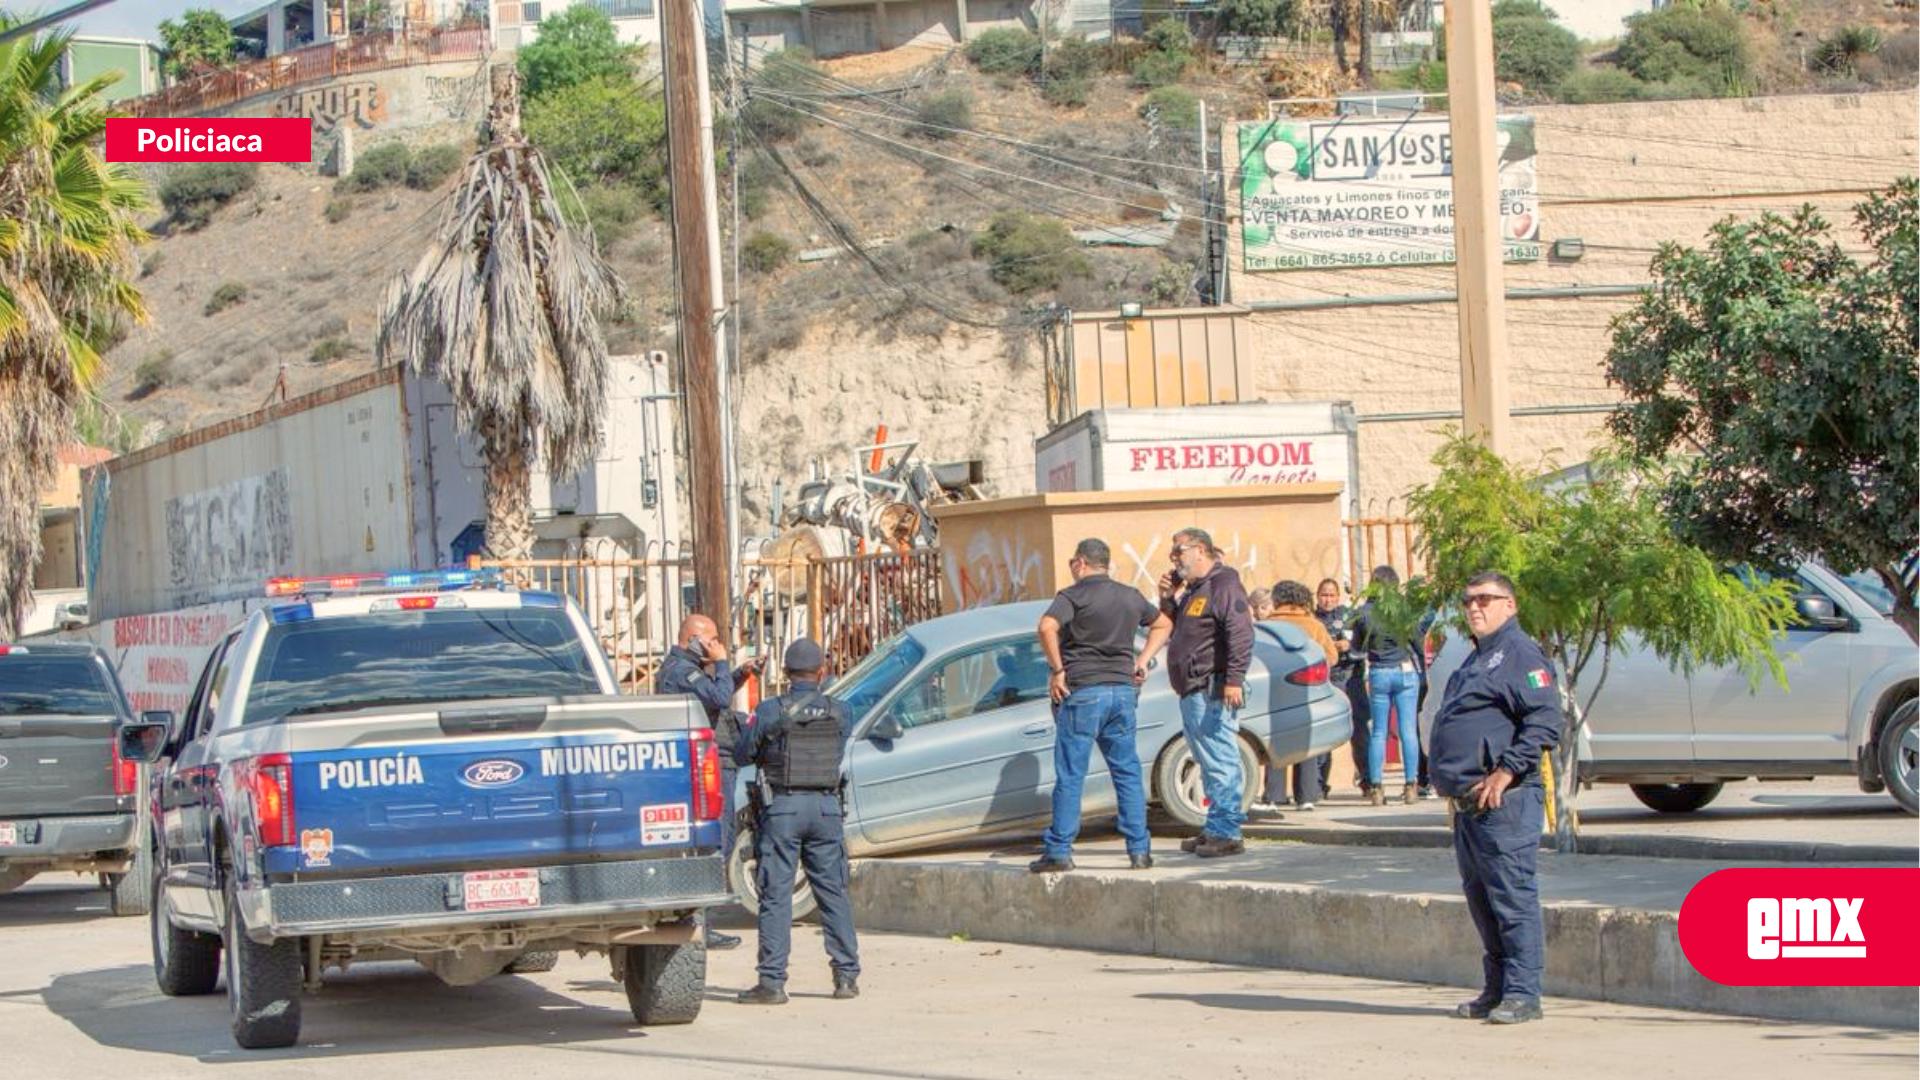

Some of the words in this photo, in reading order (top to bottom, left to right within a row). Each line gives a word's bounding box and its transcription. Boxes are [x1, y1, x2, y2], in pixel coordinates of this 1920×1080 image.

[1323, 136, 1379, 168] SAN
[1325, 194, 1333, 207] y
[1336, 190, 1393, 203] Limones
[1397, 189, 1431, 201] finos
[1434, 188, 1450, 200] de
[1317, 205, 1410, 222] MAYOREO
[1415, 204, 1426, 218] Y
[1348, 226, 1365, 239] de
[1368, 225, 1419, 238] entrega
[1274, 254, 1309, 270] (664)
[1389, 248, 1438, 263] Celular
[1130, 442, 1313, 471] FREEDOM
[541, 742, 684, 777] MUNICIPAL
[320, 752, 424, 790] POLICÍA
[474, 764, 513, 781] Ford
[645, 808, 684, 823] 911
